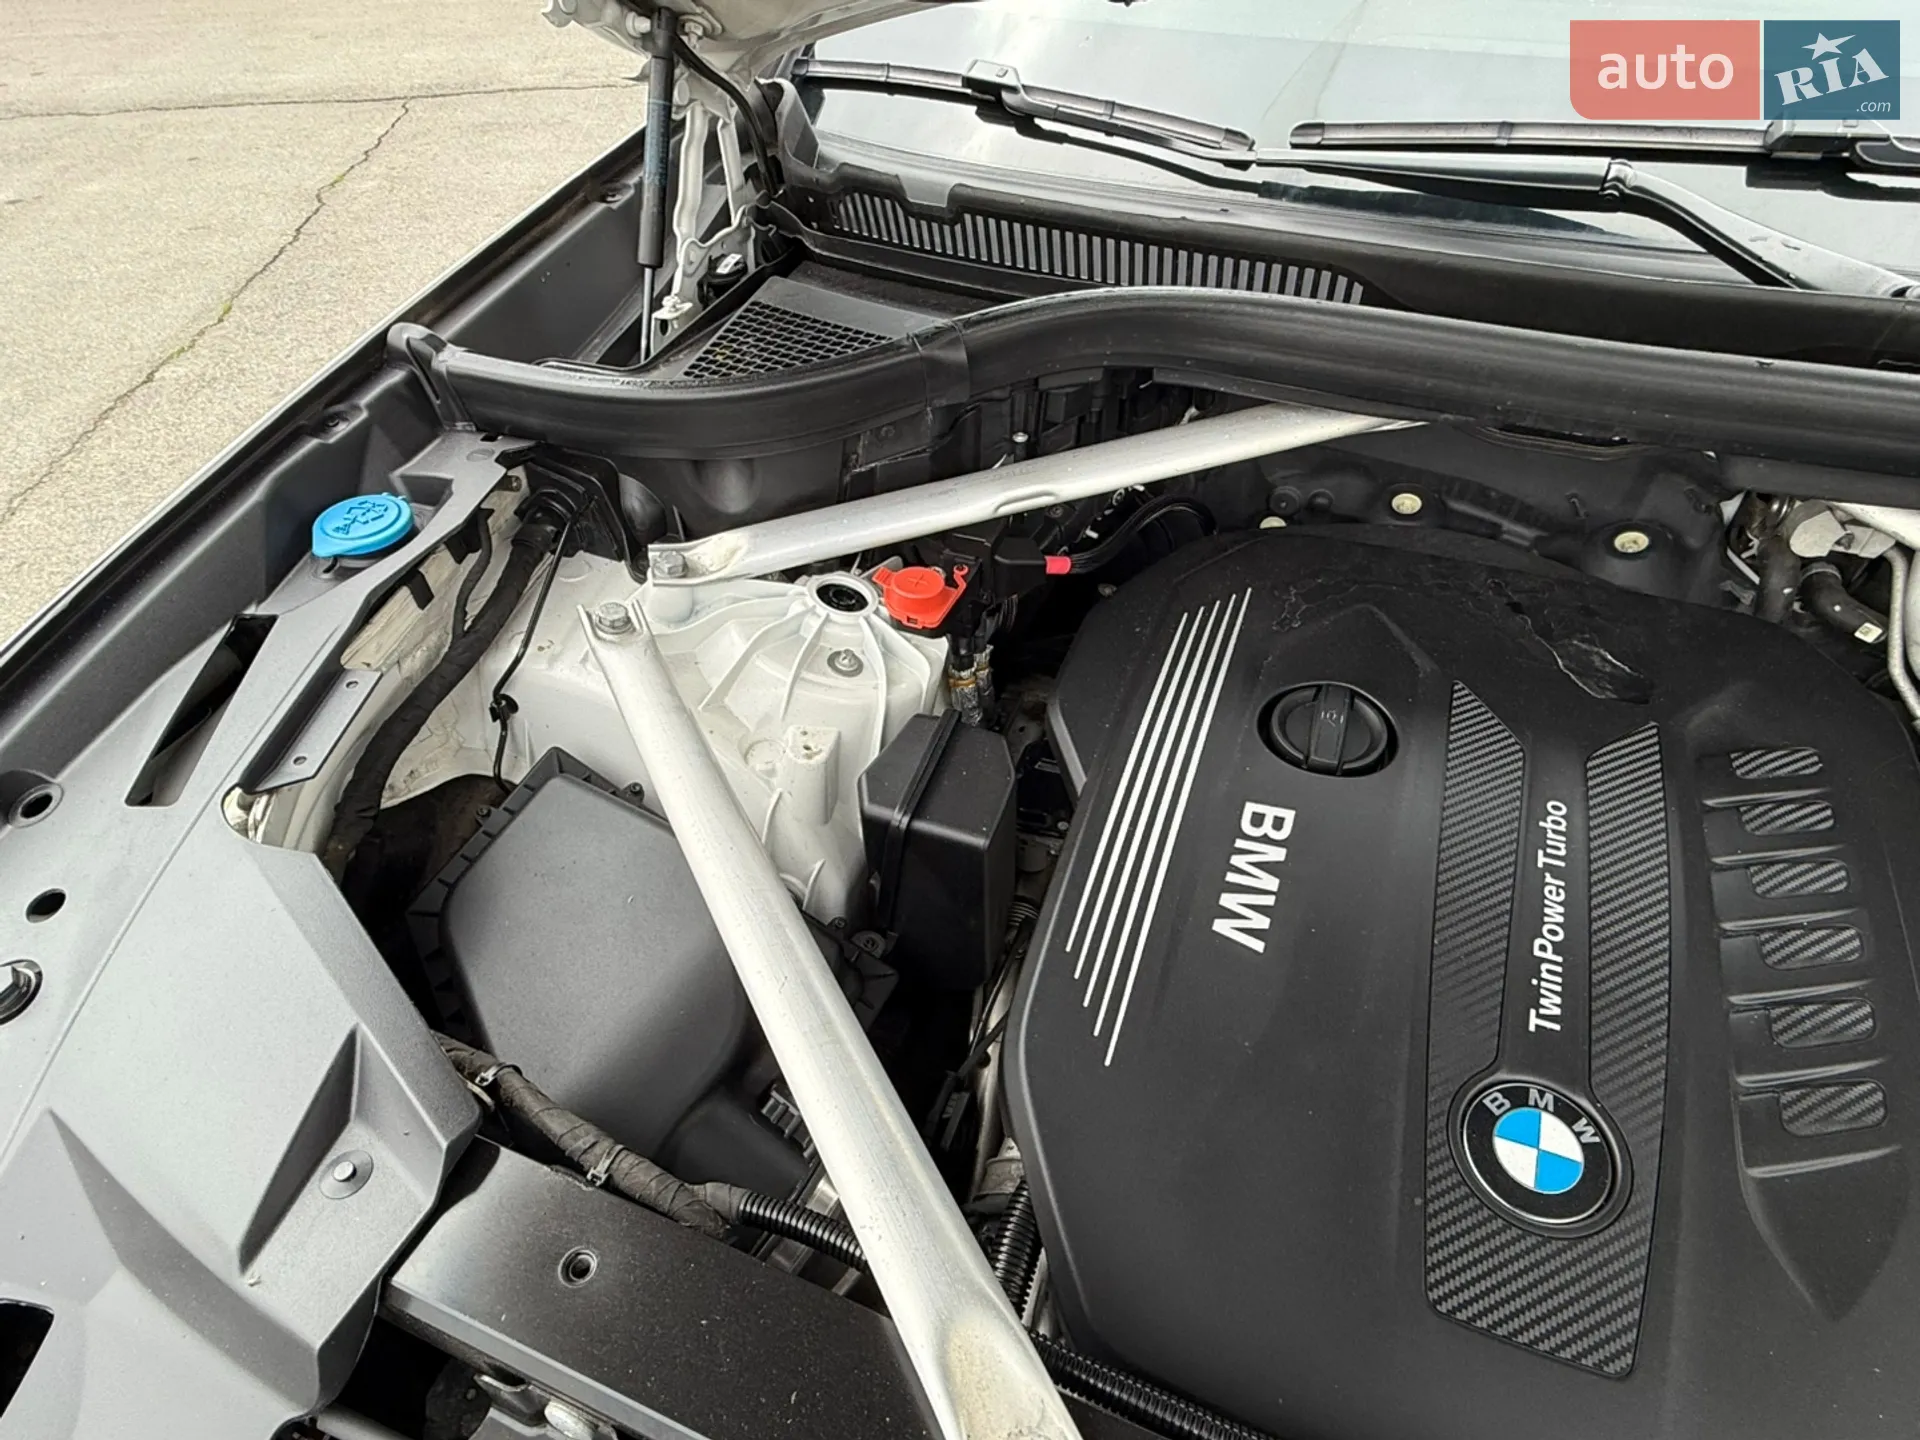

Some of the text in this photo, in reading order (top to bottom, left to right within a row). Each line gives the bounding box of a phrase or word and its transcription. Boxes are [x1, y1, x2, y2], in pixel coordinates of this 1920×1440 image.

[1211, 801, 1296, 954] BMW
[1529, 799, 1568, 1033] TwinPower Turbo
[1482, 1087, 1601, 1144] BMW
